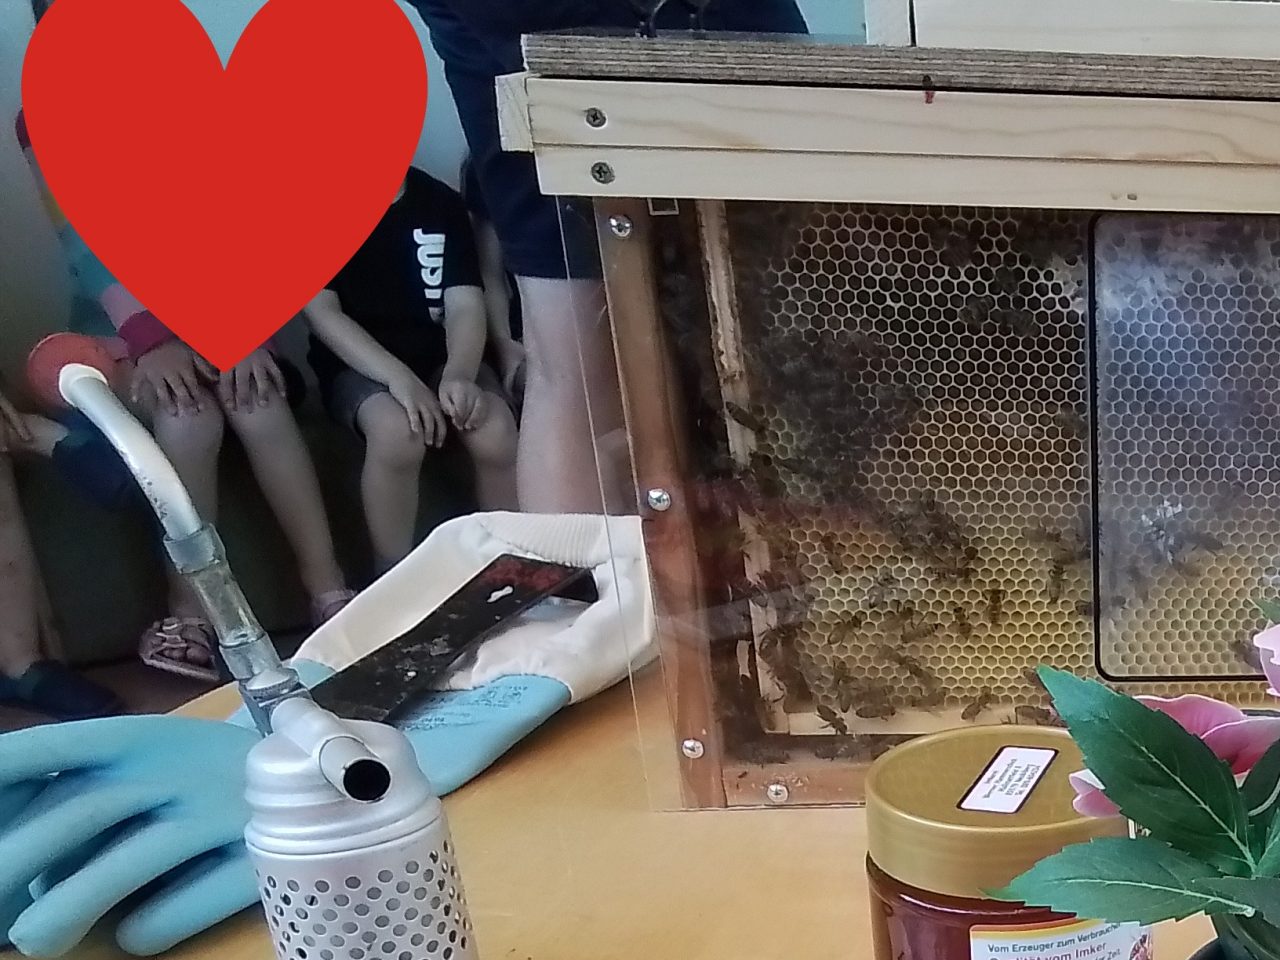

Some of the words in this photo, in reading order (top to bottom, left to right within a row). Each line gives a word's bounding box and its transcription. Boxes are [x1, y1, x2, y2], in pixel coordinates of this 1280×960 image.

[988, 943, 1009, 953] Vom
[1012, 941, 1054, 953] Erzeuger
[1056, 938, 1075, 948] zum
[1075, 942, 1107, 959] Imker
